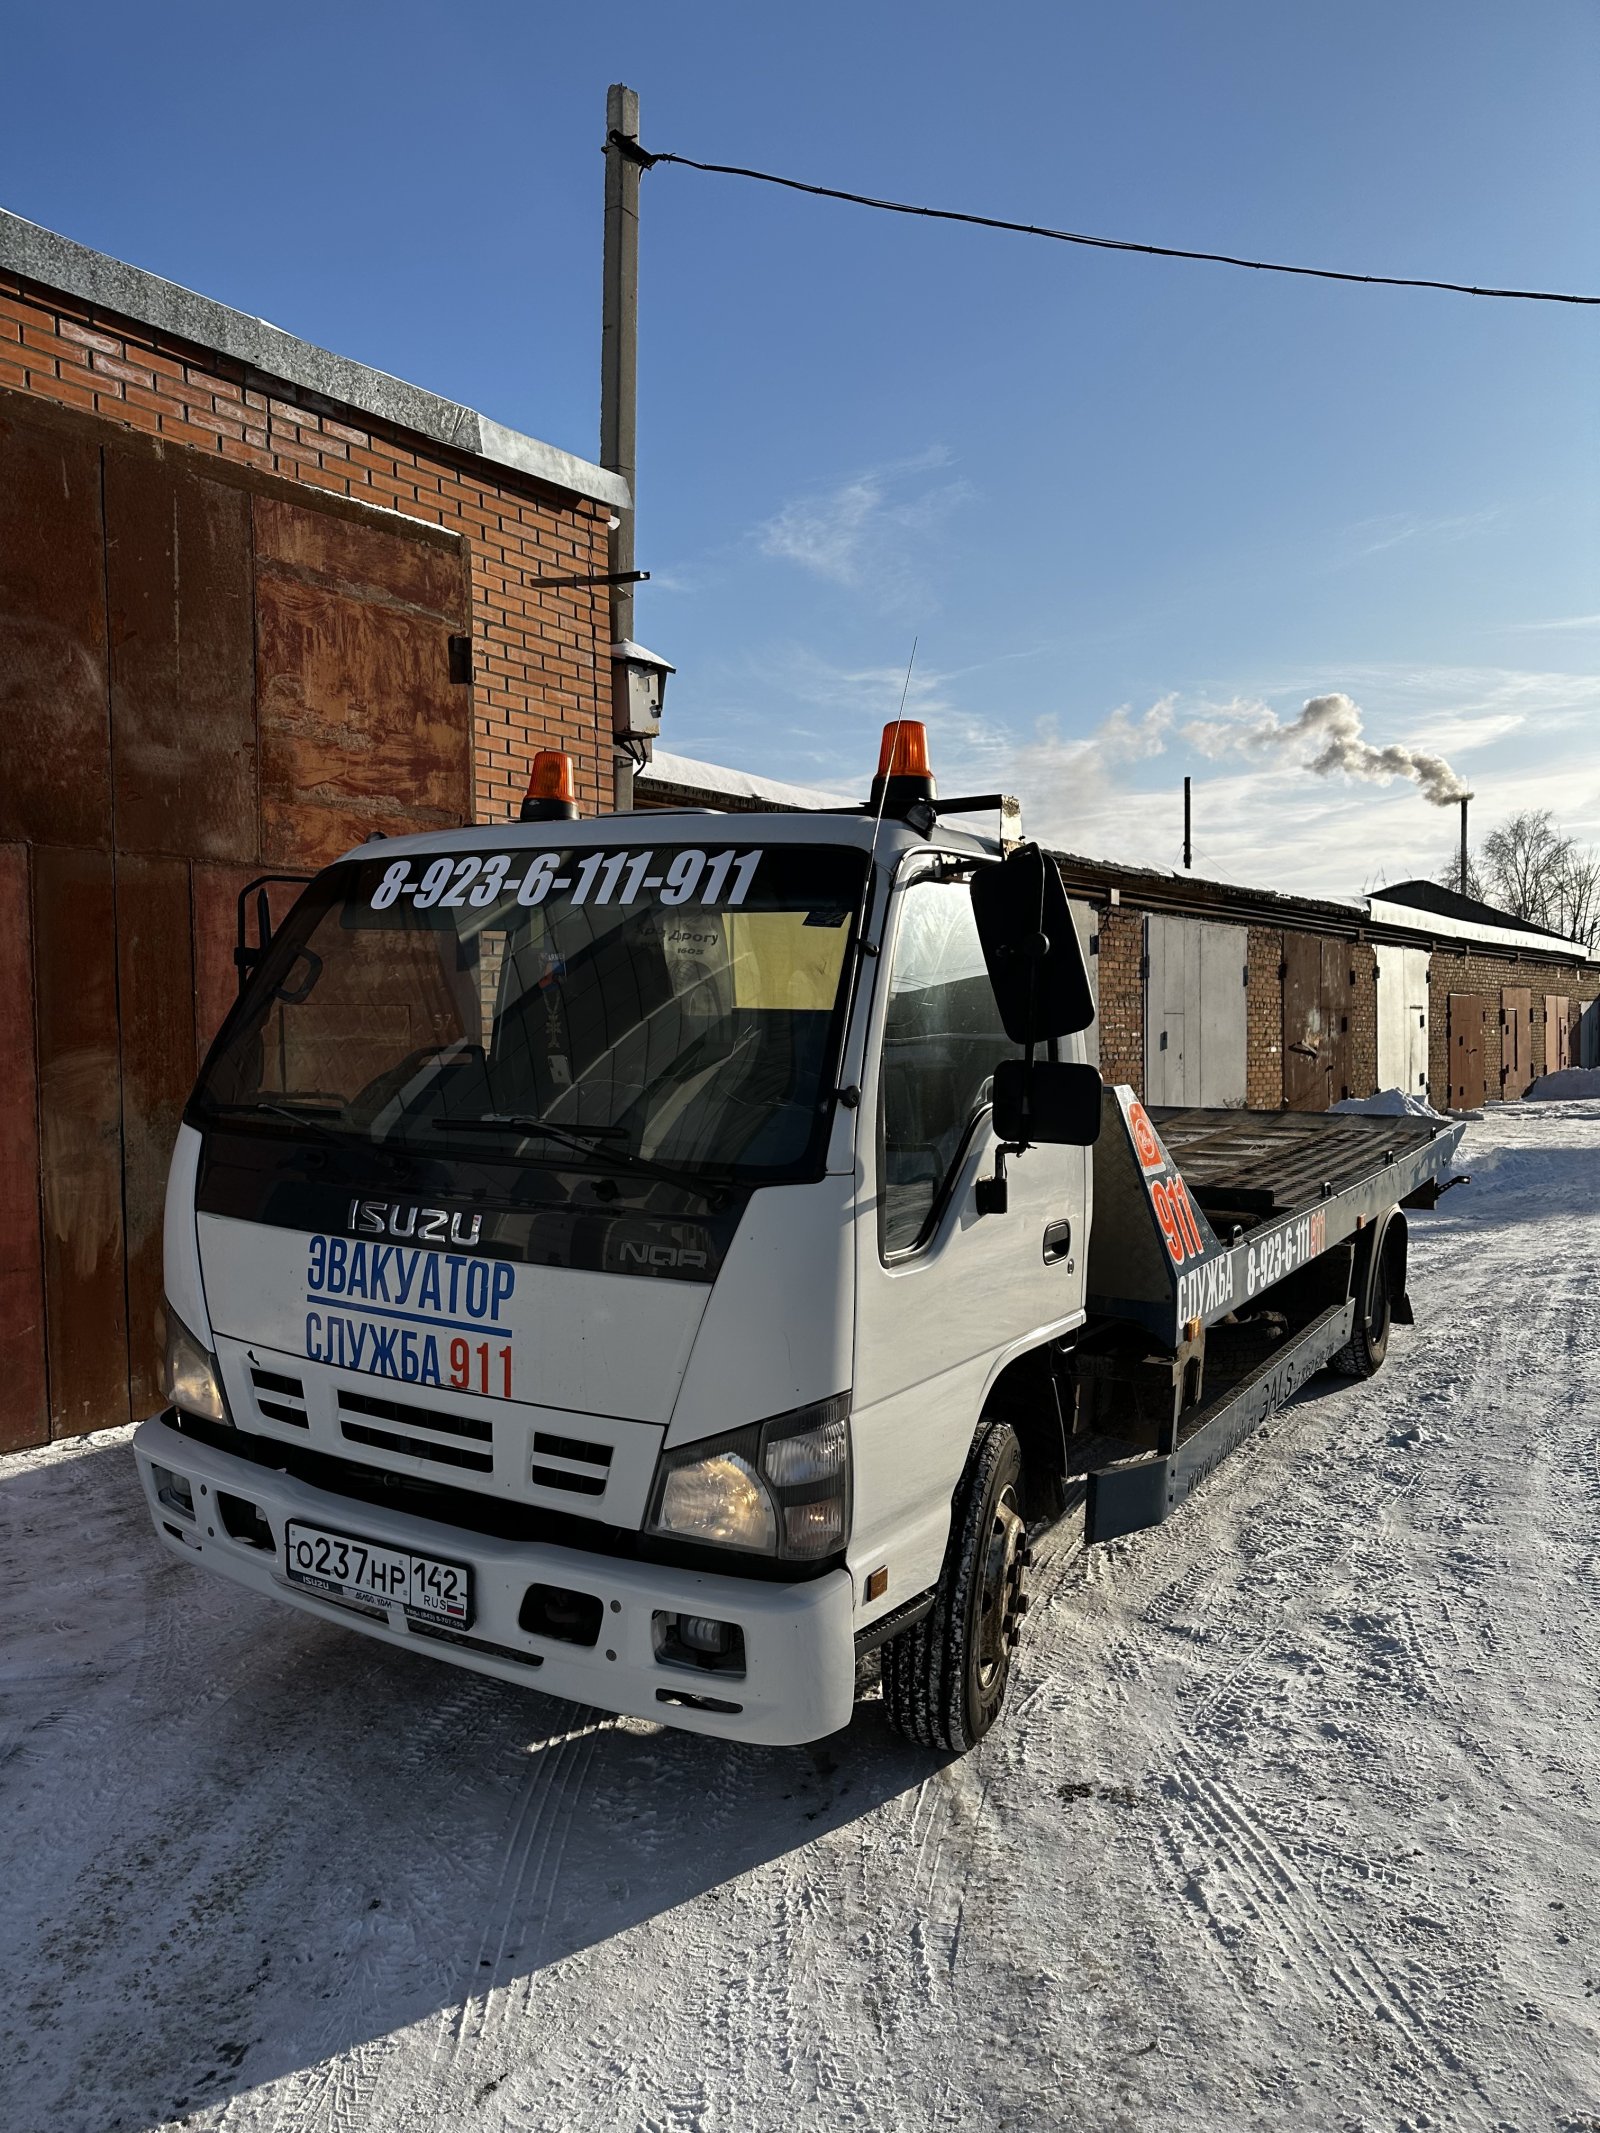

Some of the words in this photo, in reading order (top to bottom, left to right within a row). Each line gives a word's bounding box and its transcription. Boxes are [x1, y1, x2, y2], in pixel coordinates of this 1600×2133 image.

[371, 849, 764, 909] 8-923-6-111-911
[347, 1199, 483, 1247] ISUZU
[1151, 1173, 1204, 1265] 911
[307, 1235, 516, 1321] ЭВАКУАТОР
[620, 1241, 707, 1269] NQR
[1178, 1253, 1233, 1330] СЛУЖБА
[306, 1312, 441, 1386] СЛУЖБА
[450, 1337, 513, 1398] 911
[302, 1576, 329, 1591] ISUZU
[413, 1562, 458, 1601] 142
[423, 1595, 447, 1611] RUS
